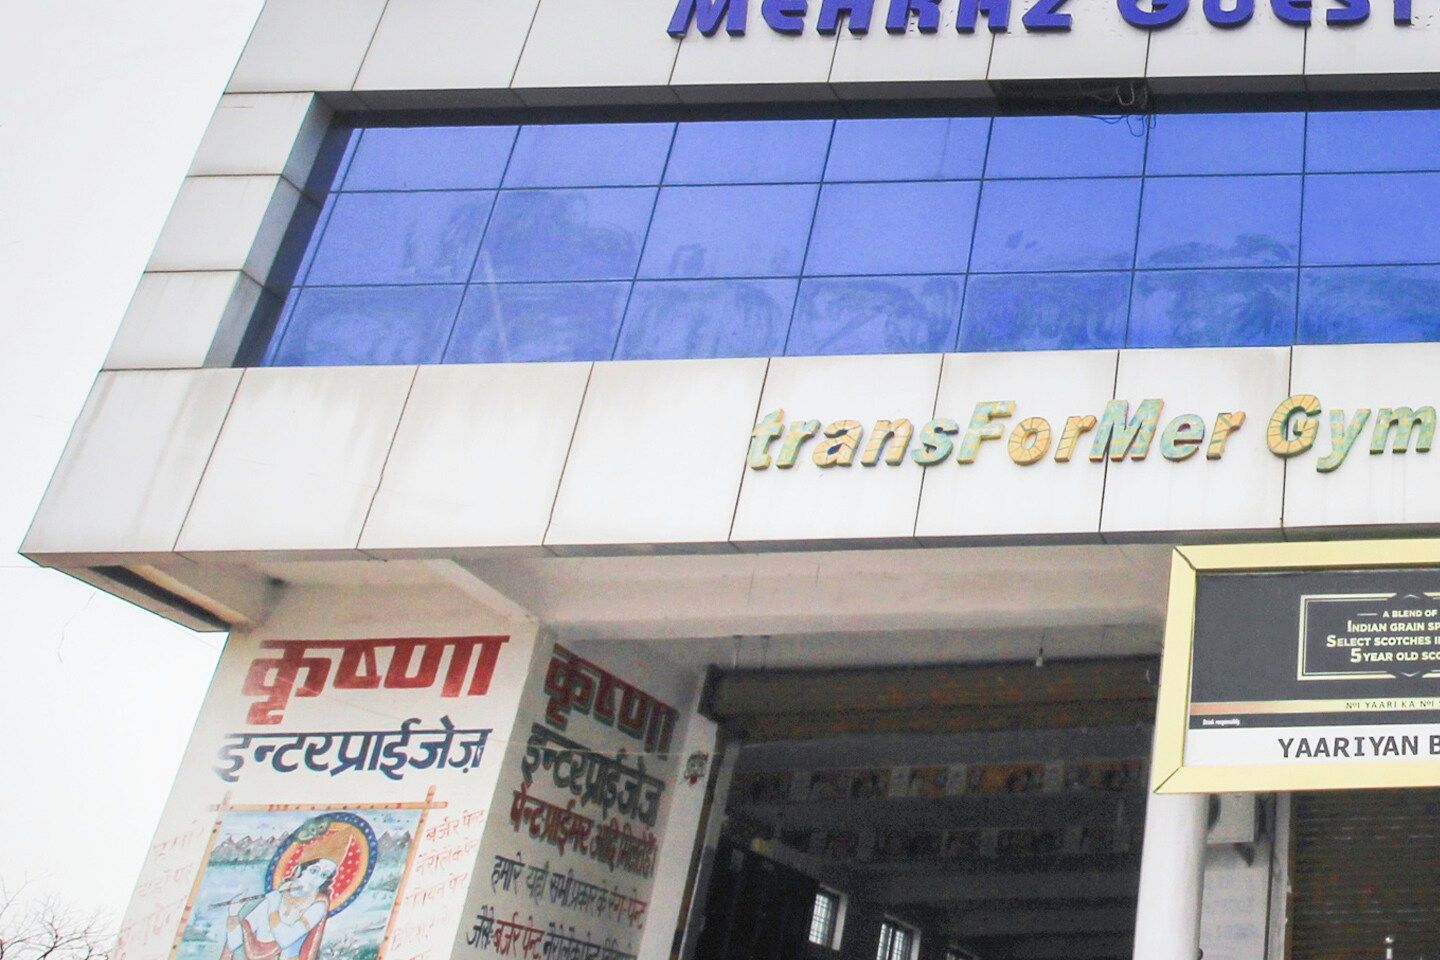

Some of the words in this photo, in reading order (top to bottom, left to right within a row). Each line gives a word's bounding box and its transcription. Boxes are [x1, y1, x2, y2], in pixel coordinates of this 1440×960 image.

[747, 399, 1246, 471] transForMer
[1266, 394, 1438, 474] Gym
[1392, 610, 1423, 618] BLEND
[1424, 609, 1438, 618] OF
[1390, 623, 1425, 632] GRAIN
[1374, 636, 1431, 646] SCOTCHES
[1363, 652, 1393, 661] YEAR
[1396, 651, 1419, 661] OLD
[241, 635, 511, 725] कृष्णा
[545, 642, 681, 761] कृष्णा
[1278, 736, 1419, 759] YAARIYAN
